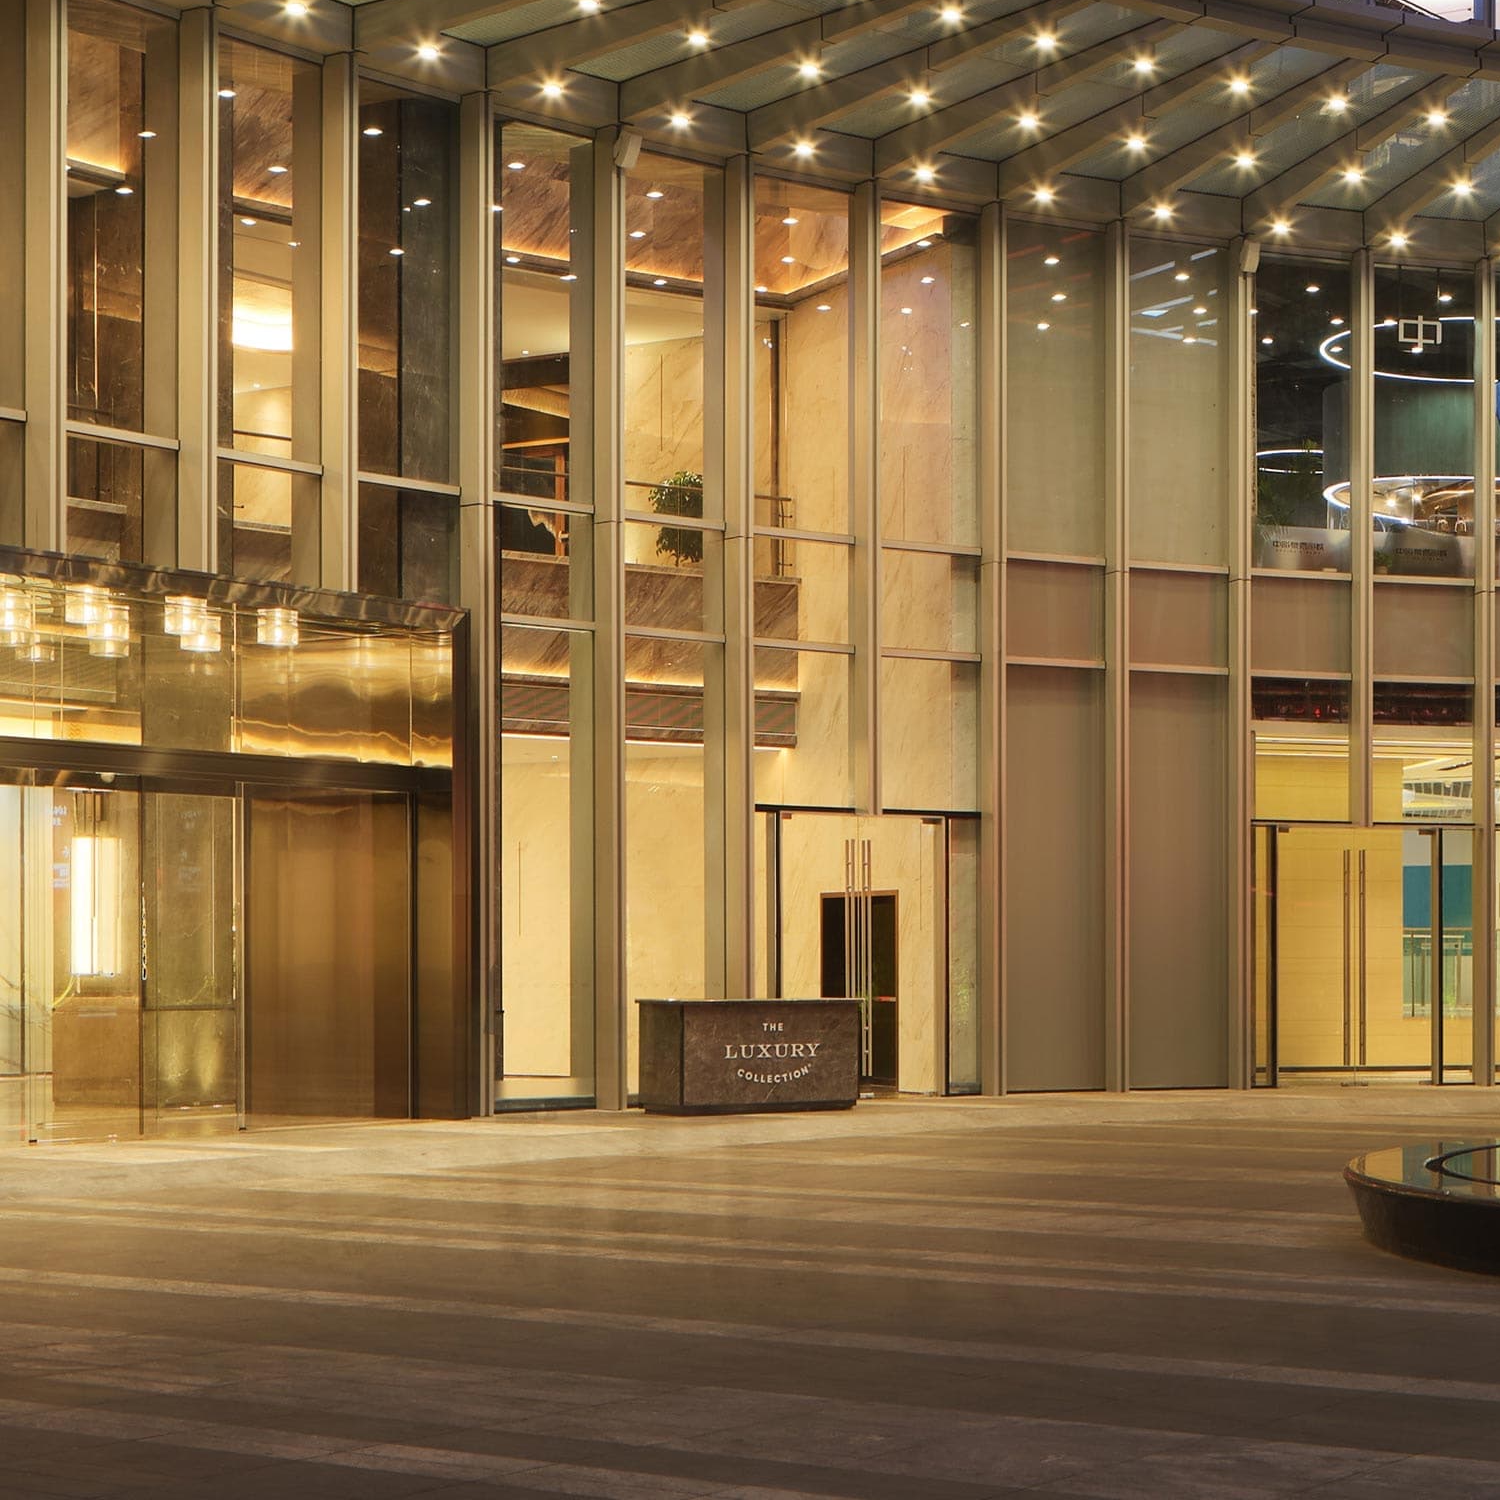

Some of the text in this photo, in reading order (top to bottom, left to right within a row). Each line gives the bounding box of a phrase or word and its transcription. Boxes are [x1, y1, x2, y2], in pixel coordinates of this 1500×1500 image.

[762, 1022, 784, 1032] THE
[724, 1043, 821, 1060] LUXURY
[736, 1065, 809, 1084] COLLECTION
